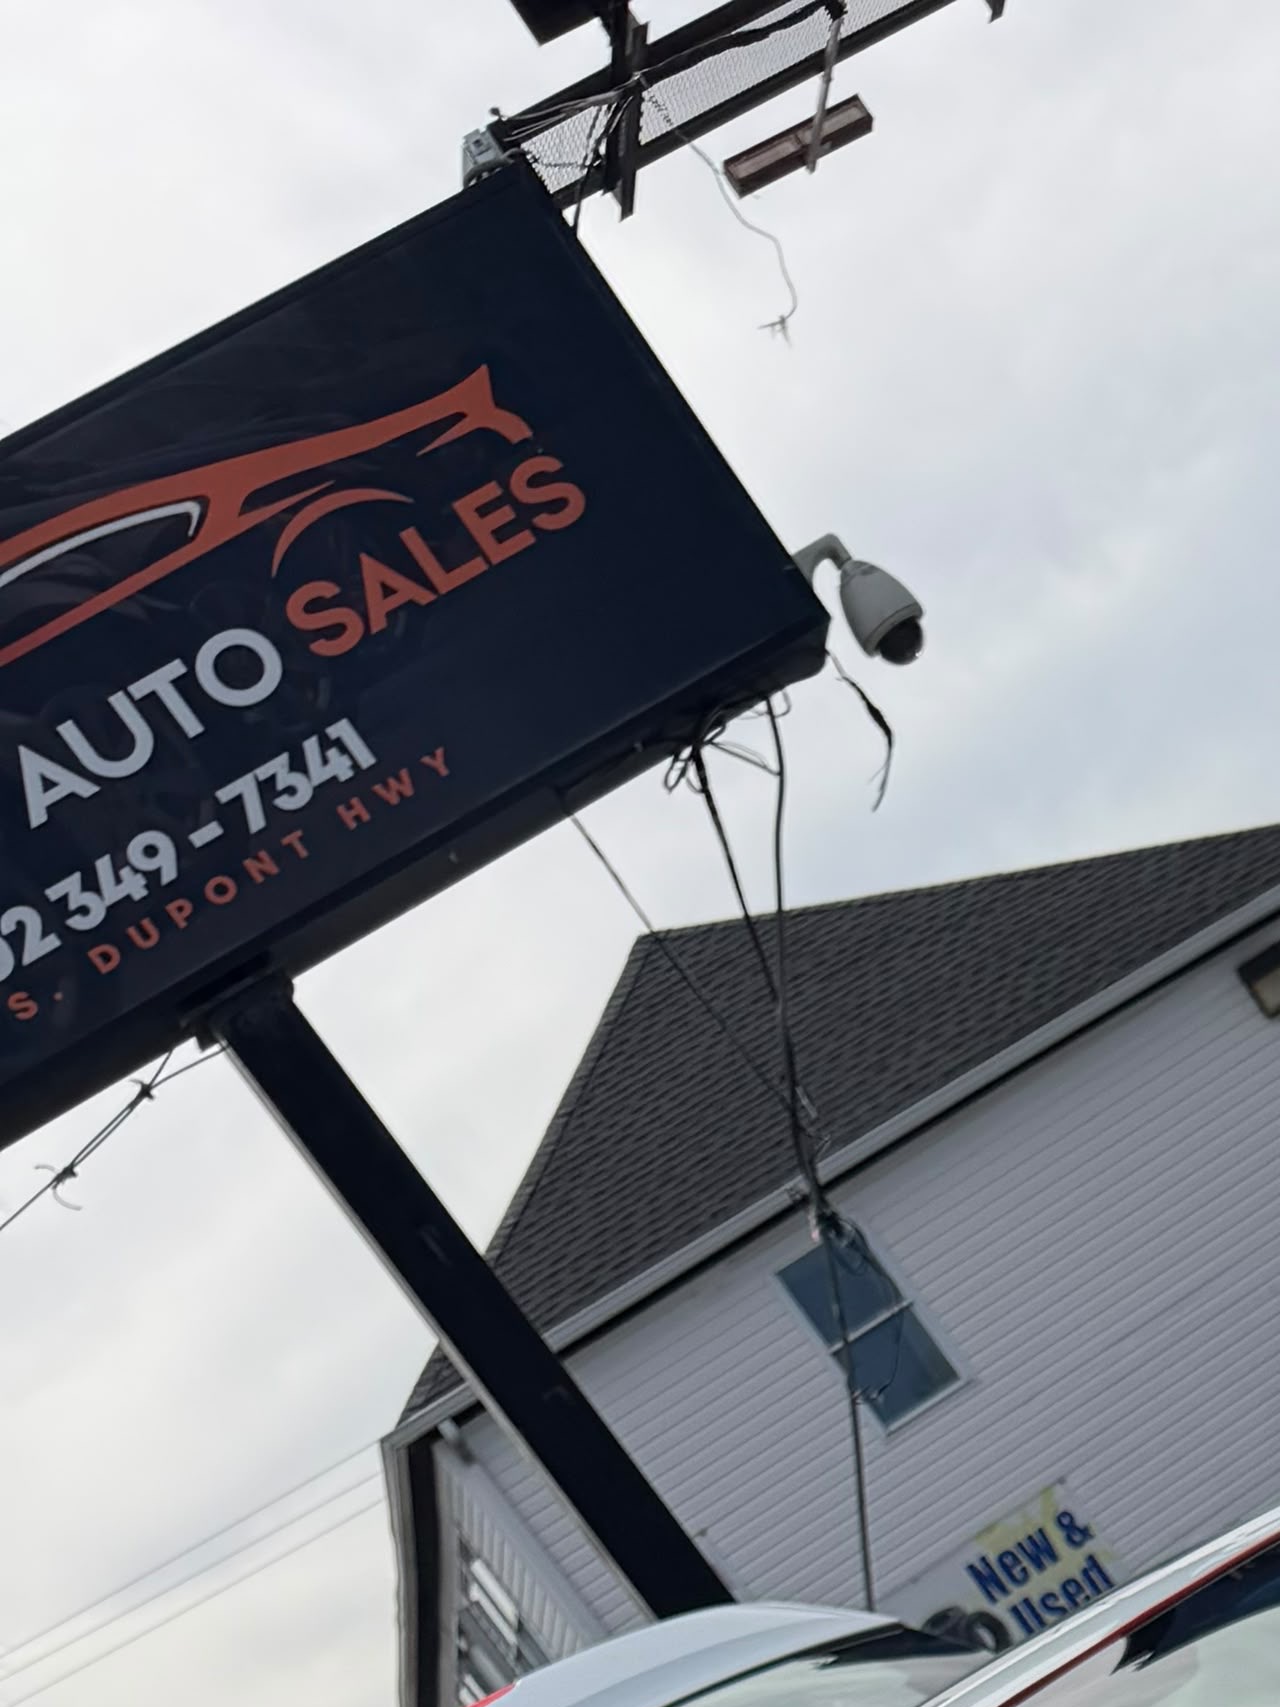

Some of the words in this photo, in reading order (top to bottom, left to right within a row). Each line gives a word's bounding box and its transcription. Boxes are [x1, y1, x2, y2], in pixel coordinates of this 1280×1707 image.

[18, 628, 282, 830] AUTO
[285, 456, 586, 657] SALES
[87, 830, 309, 974] DUPONT
[336, 747, 450, 830] HWY
[967, 1527, 1060, 1604] New
[1056, 1510, 1096, 1549] &
[1009, 1553, 1115, 1636] Used
